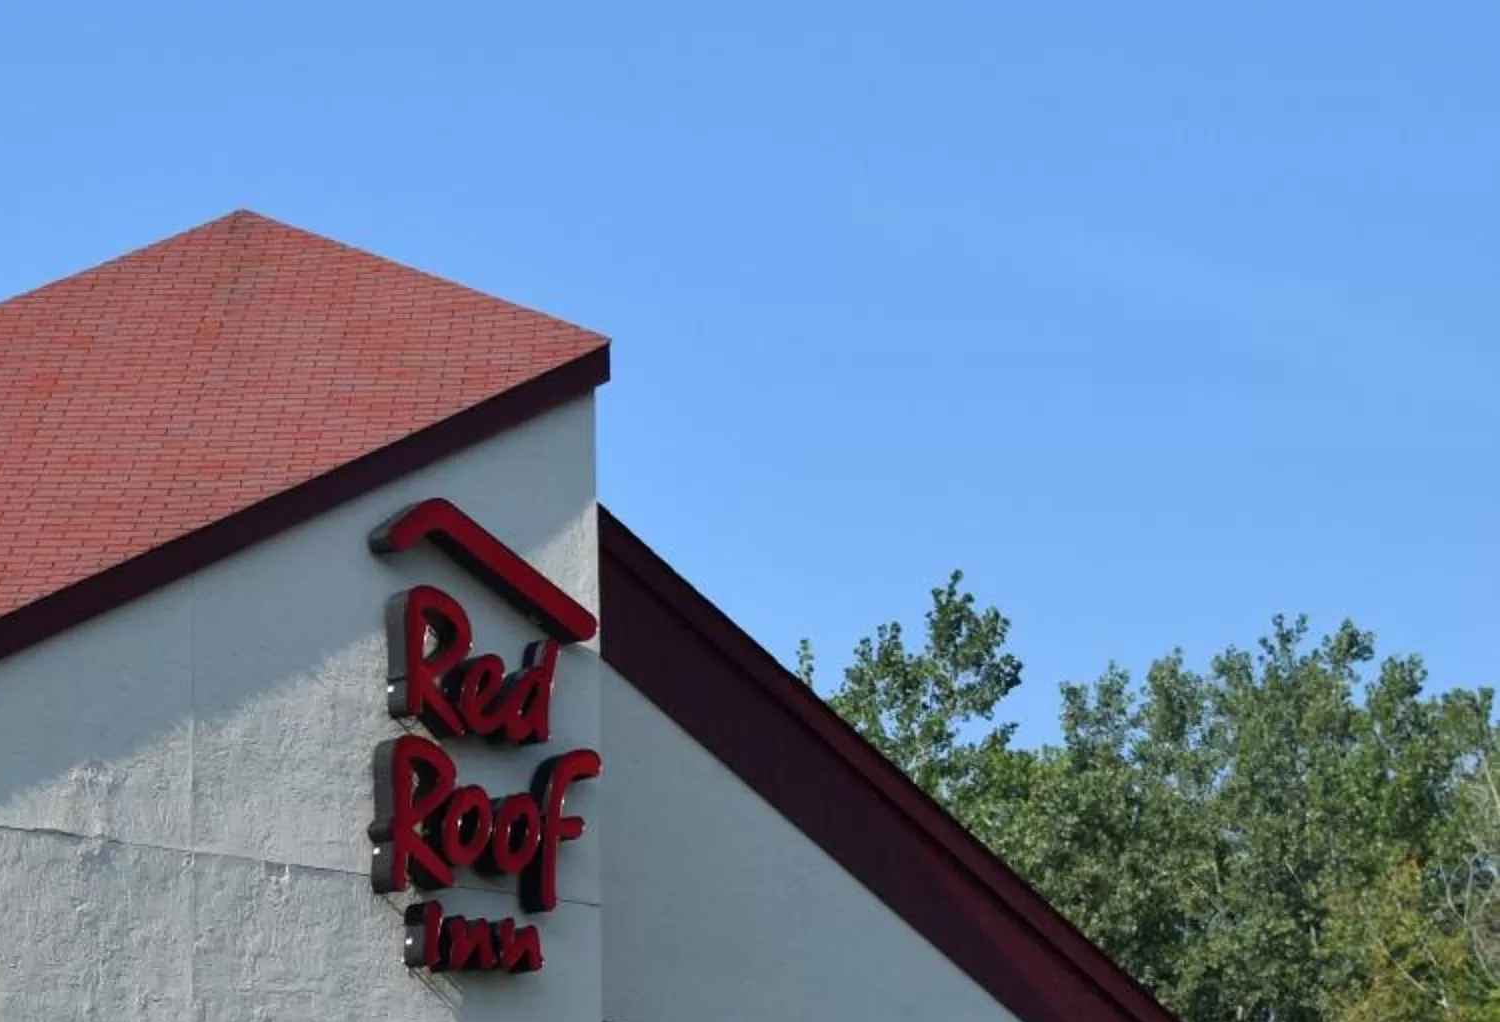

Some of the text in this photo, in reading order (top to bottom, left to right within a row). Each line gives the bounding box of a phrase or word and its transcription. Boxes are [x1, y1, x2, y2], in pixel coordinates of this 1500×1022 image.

[386, 585, 560, 744] Red
[369, 736, 602, 913] Roof
[404, 901, 544, 973] Inn
